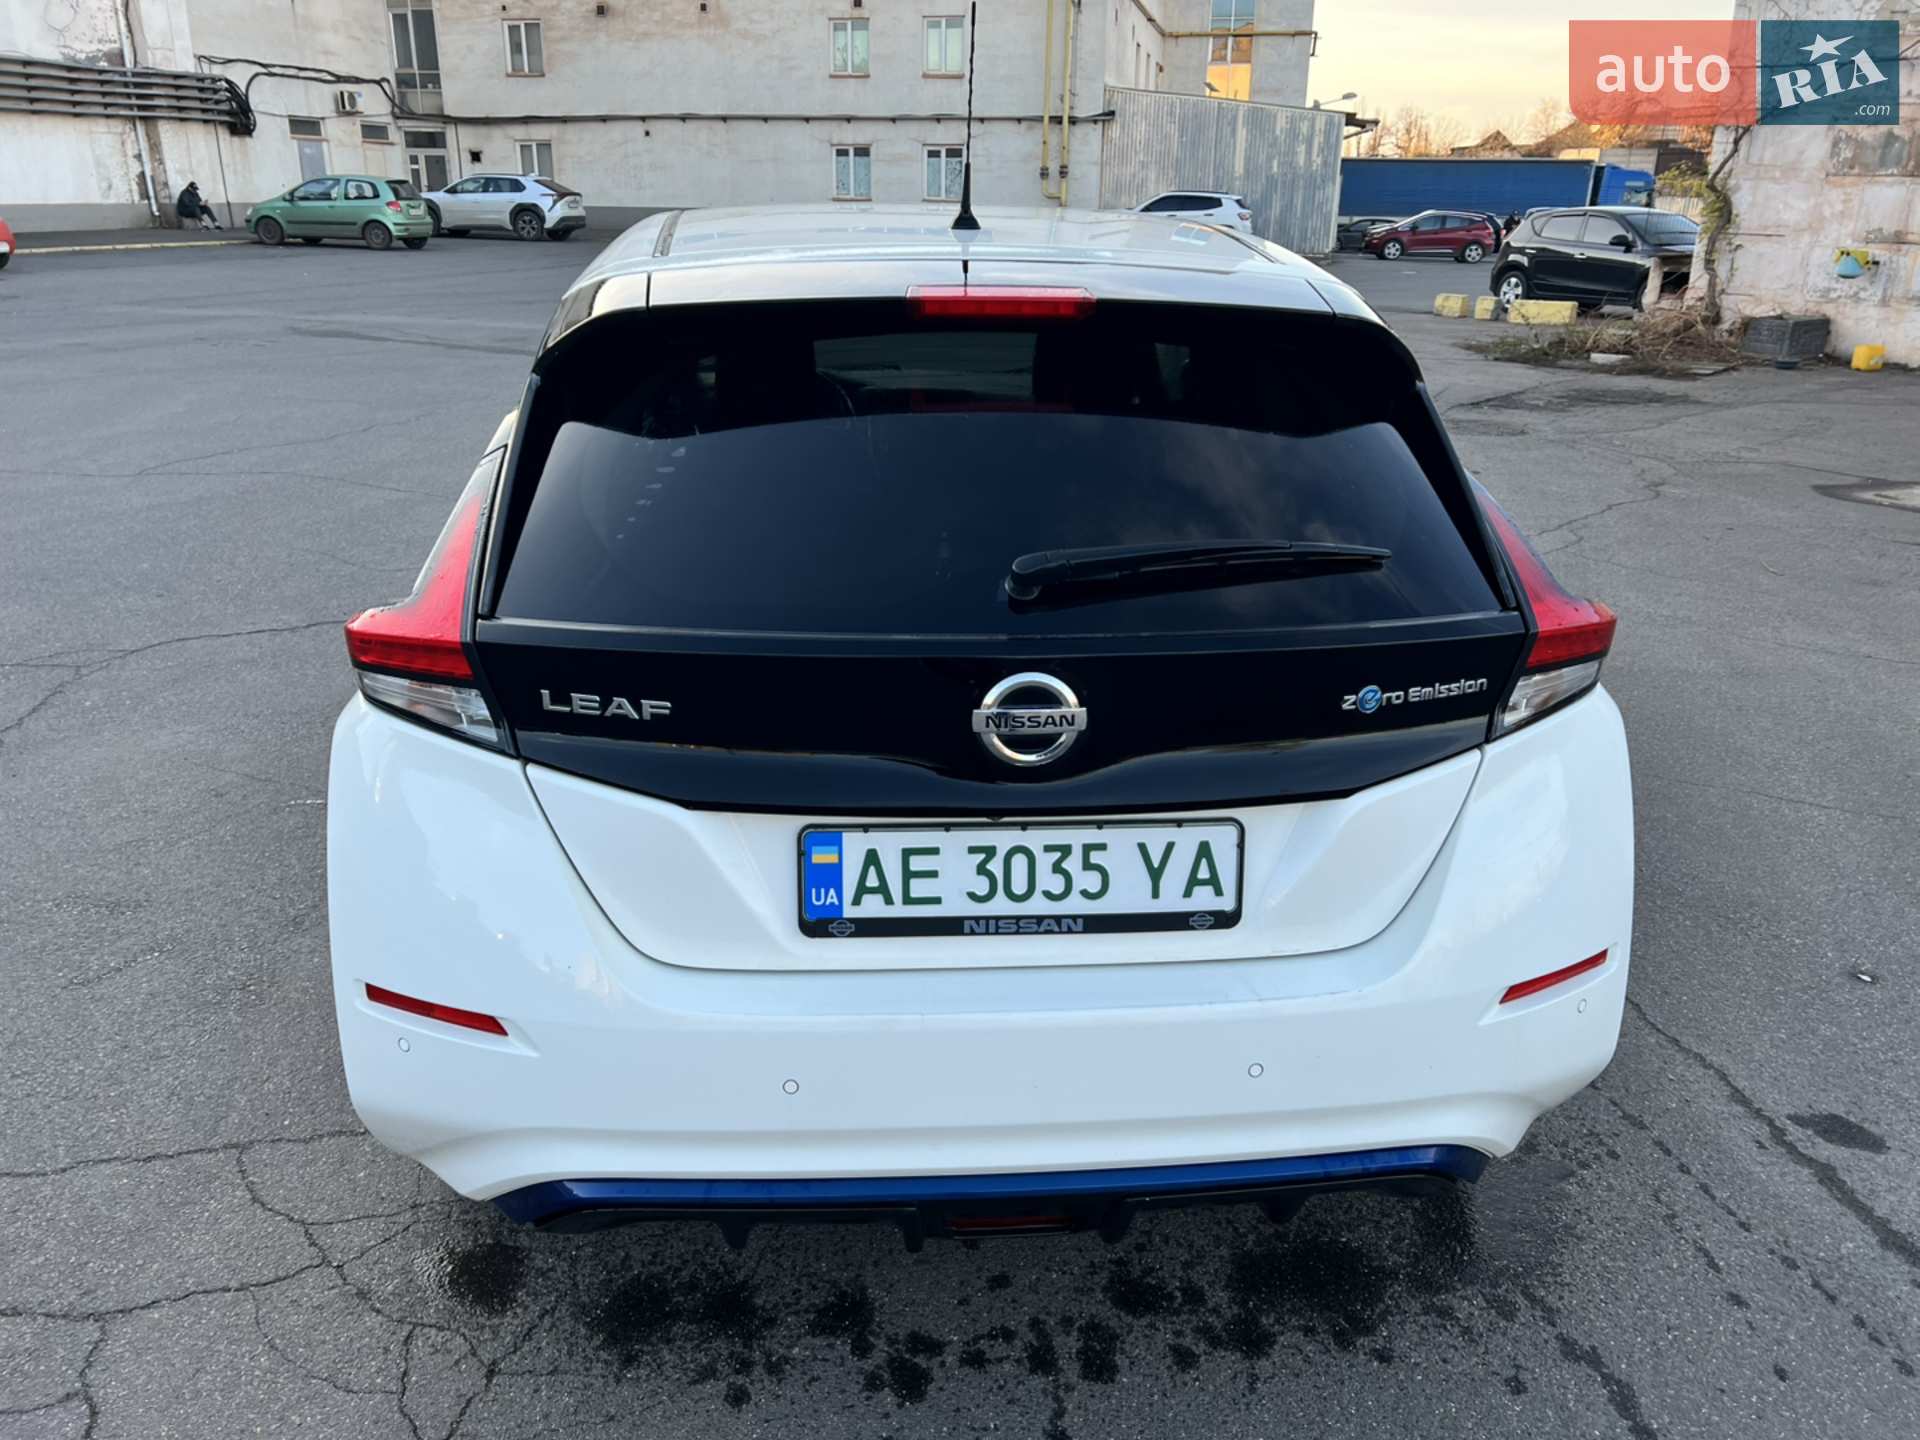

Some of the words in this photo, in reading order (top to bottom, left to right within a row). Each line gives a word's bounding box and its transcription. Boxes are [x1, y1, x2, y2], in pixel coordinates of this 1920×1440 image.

[1408, 677, 1488, 703] Emission
[540, 688, 672, 721] LEAF
[984, 713, 1076, 730] NISSAN
[850, 846, 943, 907] AE
[965, 842, 1111, 904] 3035
[1136, 839, 1225, 901] YA
[811, 888, 839, 906] UA
[962, 917, 1084, 935] NISSAN
